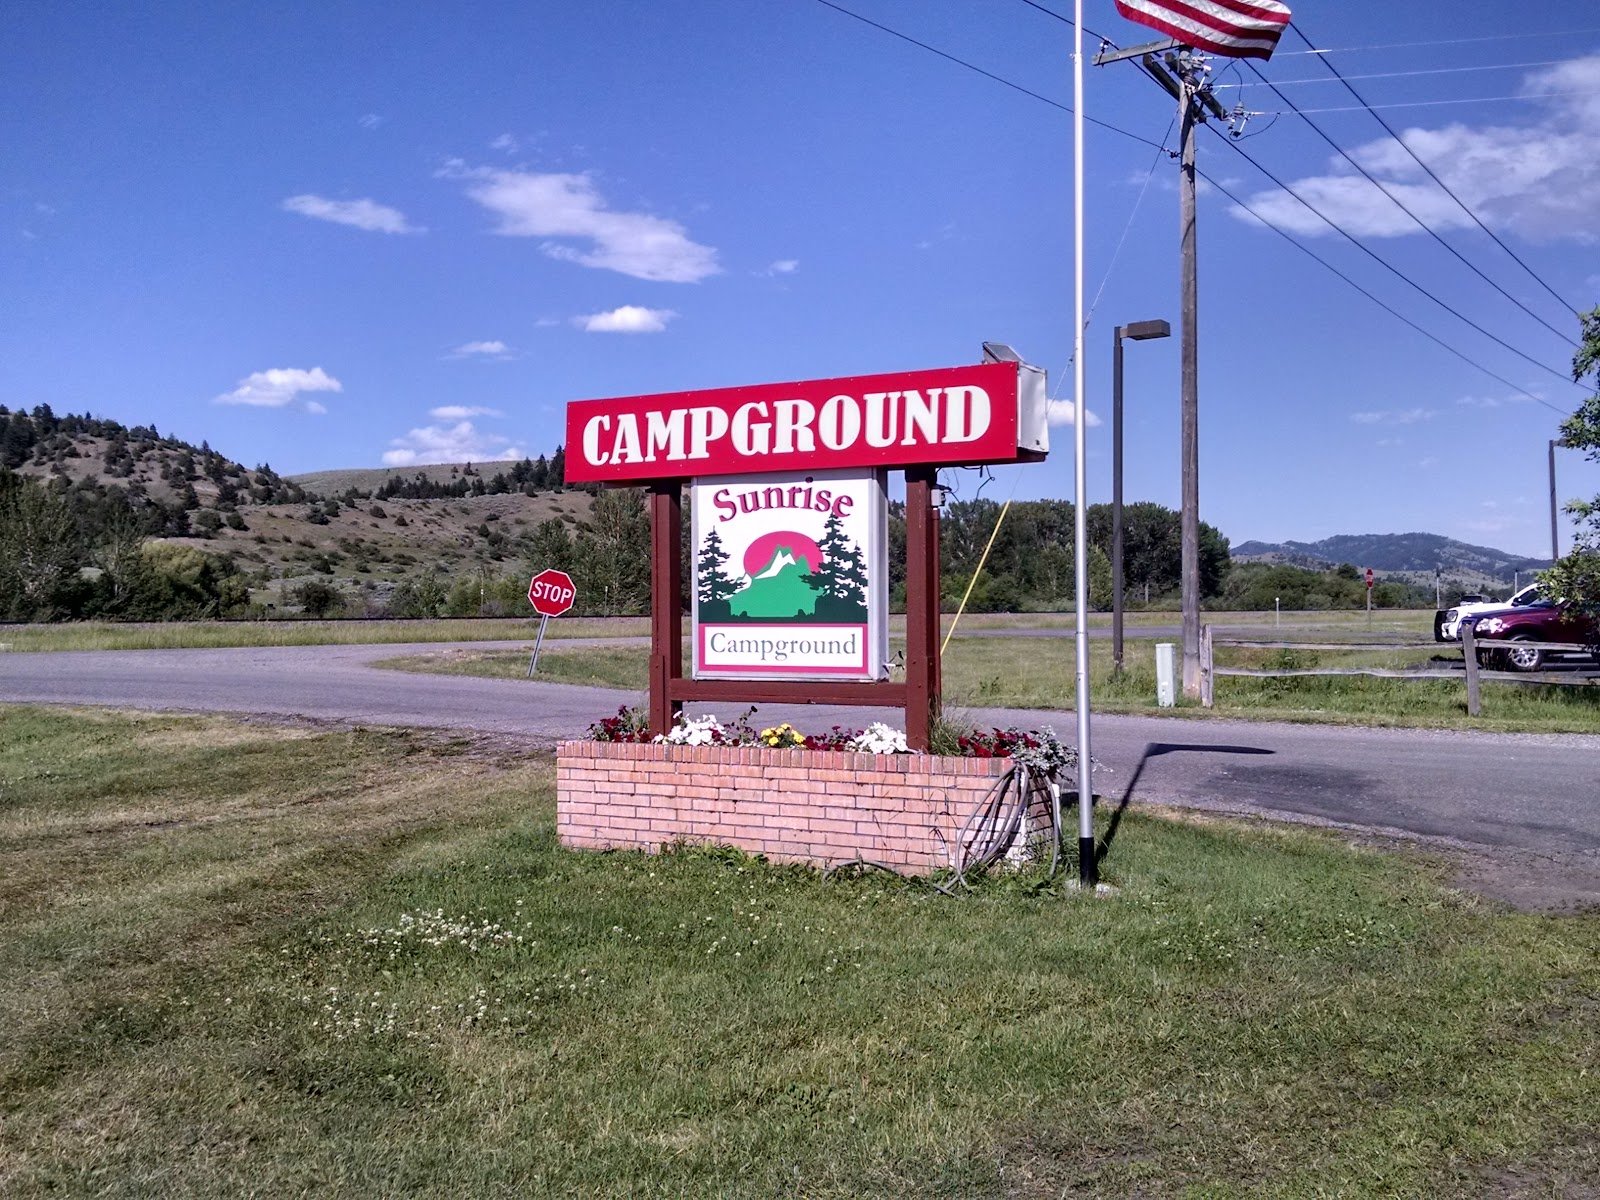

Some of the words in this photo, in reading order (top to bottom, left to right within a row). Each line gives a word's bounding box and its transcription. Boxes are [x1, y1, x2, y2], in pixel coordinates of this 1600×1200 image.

[582, 384, 991, 466] CAMPGROUND
[713, 477, 853, 522] Sunrise
[532, 581, 572, 604] STOP
[710, 632, 857, 662] Campground
